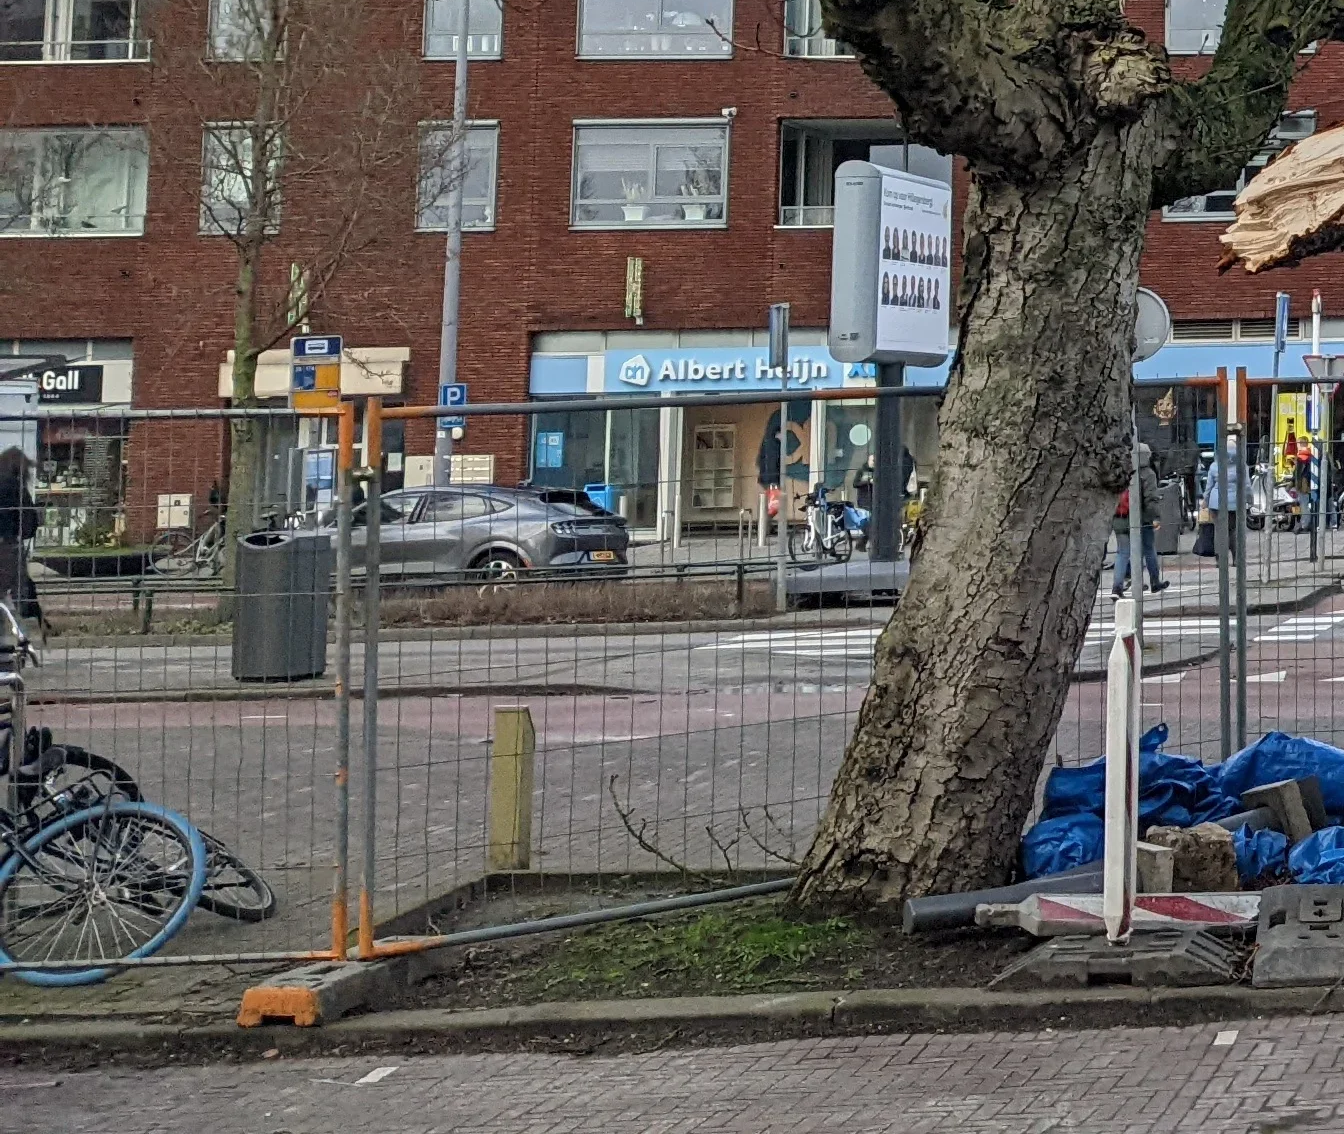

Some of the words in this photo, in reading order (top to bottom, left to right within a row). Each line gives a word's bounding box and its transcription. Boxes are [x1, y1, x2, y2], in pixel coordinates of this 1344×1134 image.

[42, 370, 80, 391] Gall
[659, 358, 745, 381] Albert
[755, 357, 829, 384] Heijn
[446, 387, 461, 406] P
